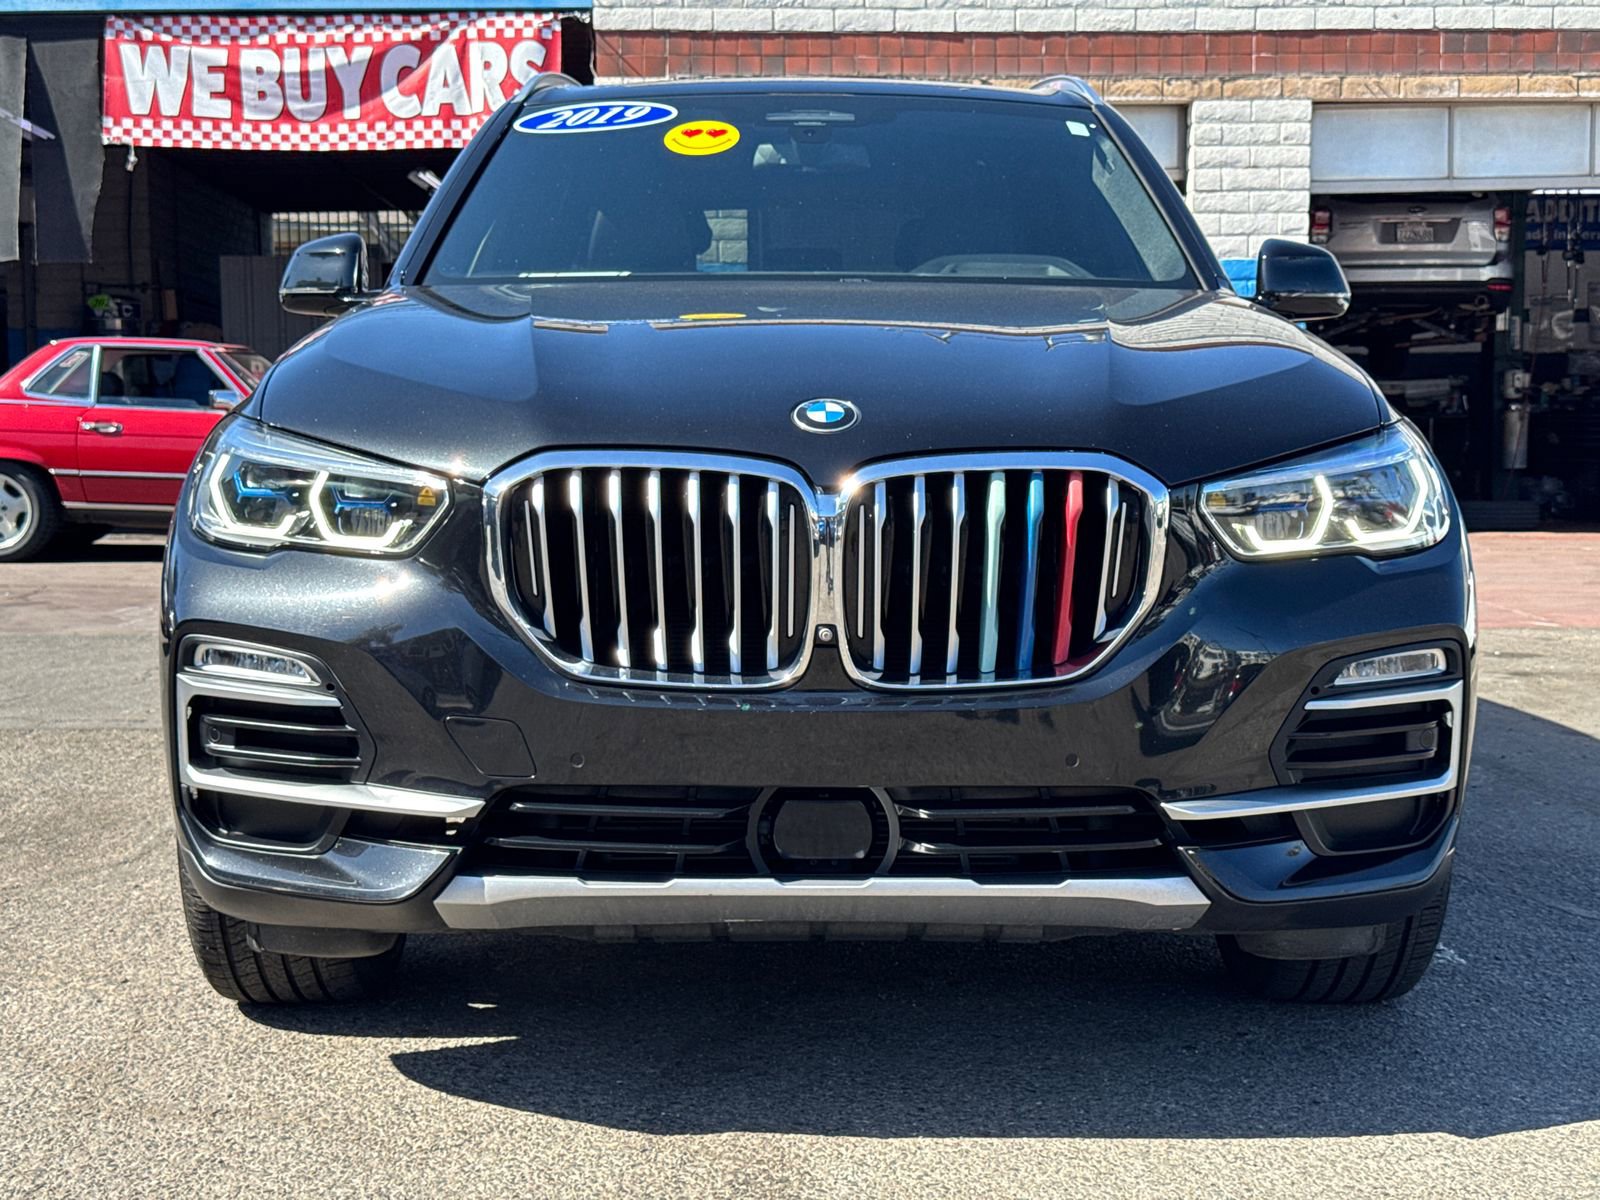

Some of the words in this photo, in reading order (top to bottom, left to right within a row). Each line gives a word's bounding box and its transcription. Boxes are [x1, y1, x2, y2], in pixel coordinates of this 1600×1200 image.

[119, 42, 232, 119] WE
[240, 46, 374, 122] BUY
[380, 39, 547, 119] CARS
[536, 105, 652, 130] 2019
